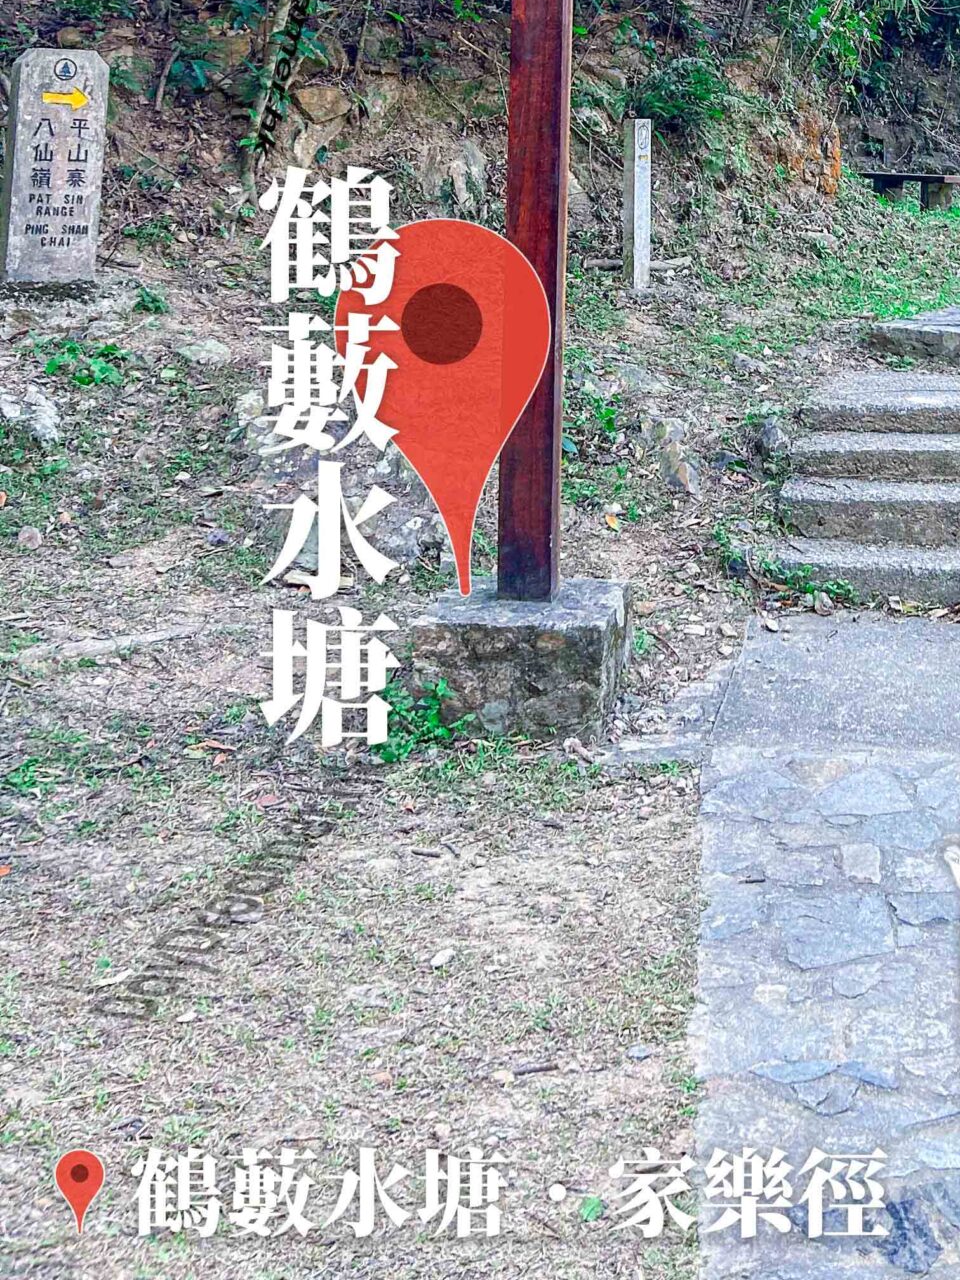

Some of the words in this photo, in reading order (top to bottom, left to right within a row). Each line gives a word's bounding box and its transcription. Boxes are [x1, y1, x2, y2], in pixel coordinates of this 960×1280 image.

[30, 118, 55, 189] 八仙嶺
[28, 193, 52, 204] PAT
[63, 193, 84, 205] SIN
[35, 206, 75, 217] RANGE
[25, 224, 49, 235] PING
[61, 224, 89, 235] SHAN
[40, 236, 71, 247] CHAI
